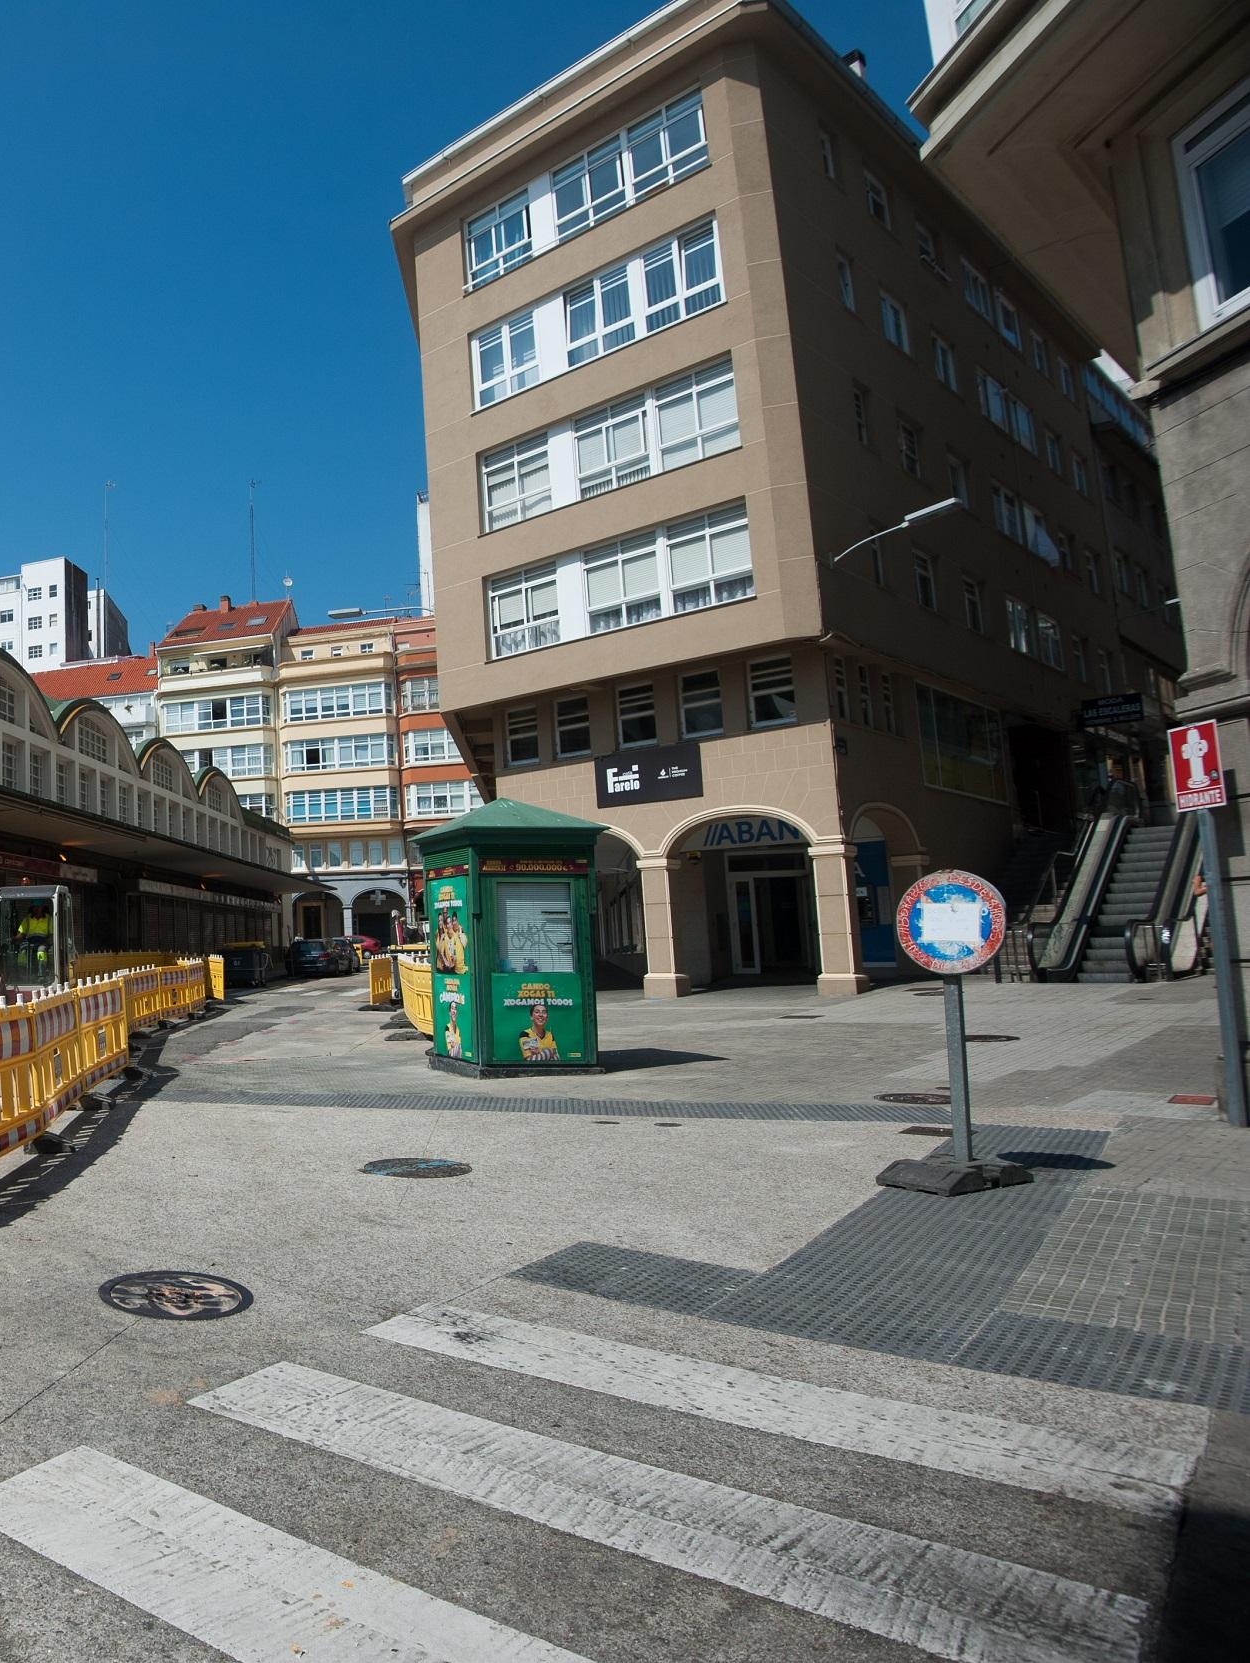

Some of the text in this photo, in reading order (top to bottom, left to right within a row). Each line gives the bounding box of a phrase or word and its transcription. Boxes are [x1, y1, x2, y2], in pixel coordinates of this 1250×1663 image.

[606, 767, 640, 794] Farelo
[503, 998, 573, 1007] XOGAMOS TODOS
